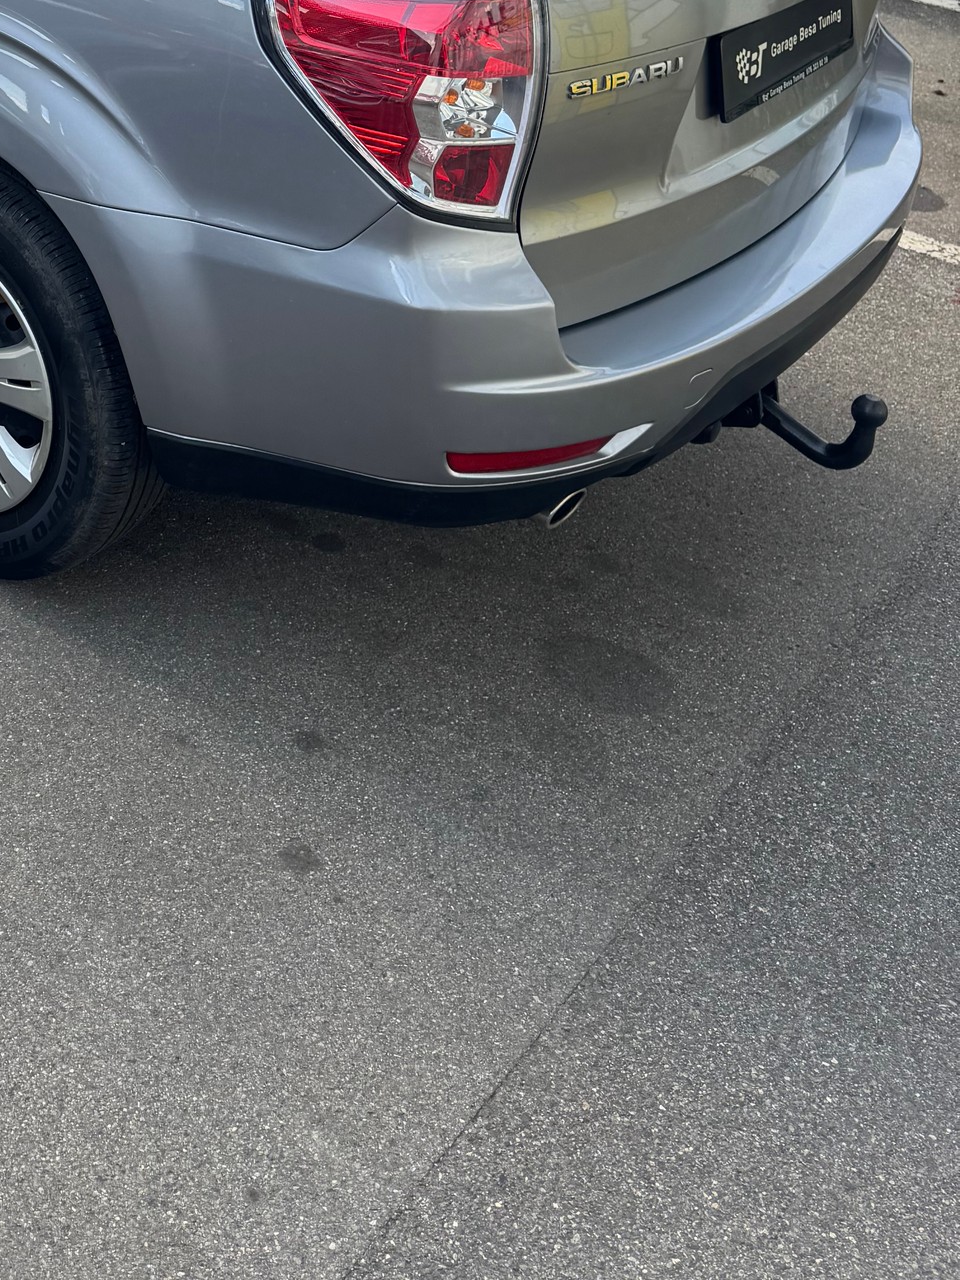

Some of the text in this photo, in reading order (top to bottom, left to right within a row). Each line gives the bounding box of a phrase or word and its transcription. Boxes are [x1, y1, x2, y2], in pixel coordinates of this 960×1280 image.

[770, 34, 798, 58] Garage
[799, 23, 817, 41] Besa
[818, 8, 842, 30] Tuning
[567, 56, 684, 99] SUBARU
